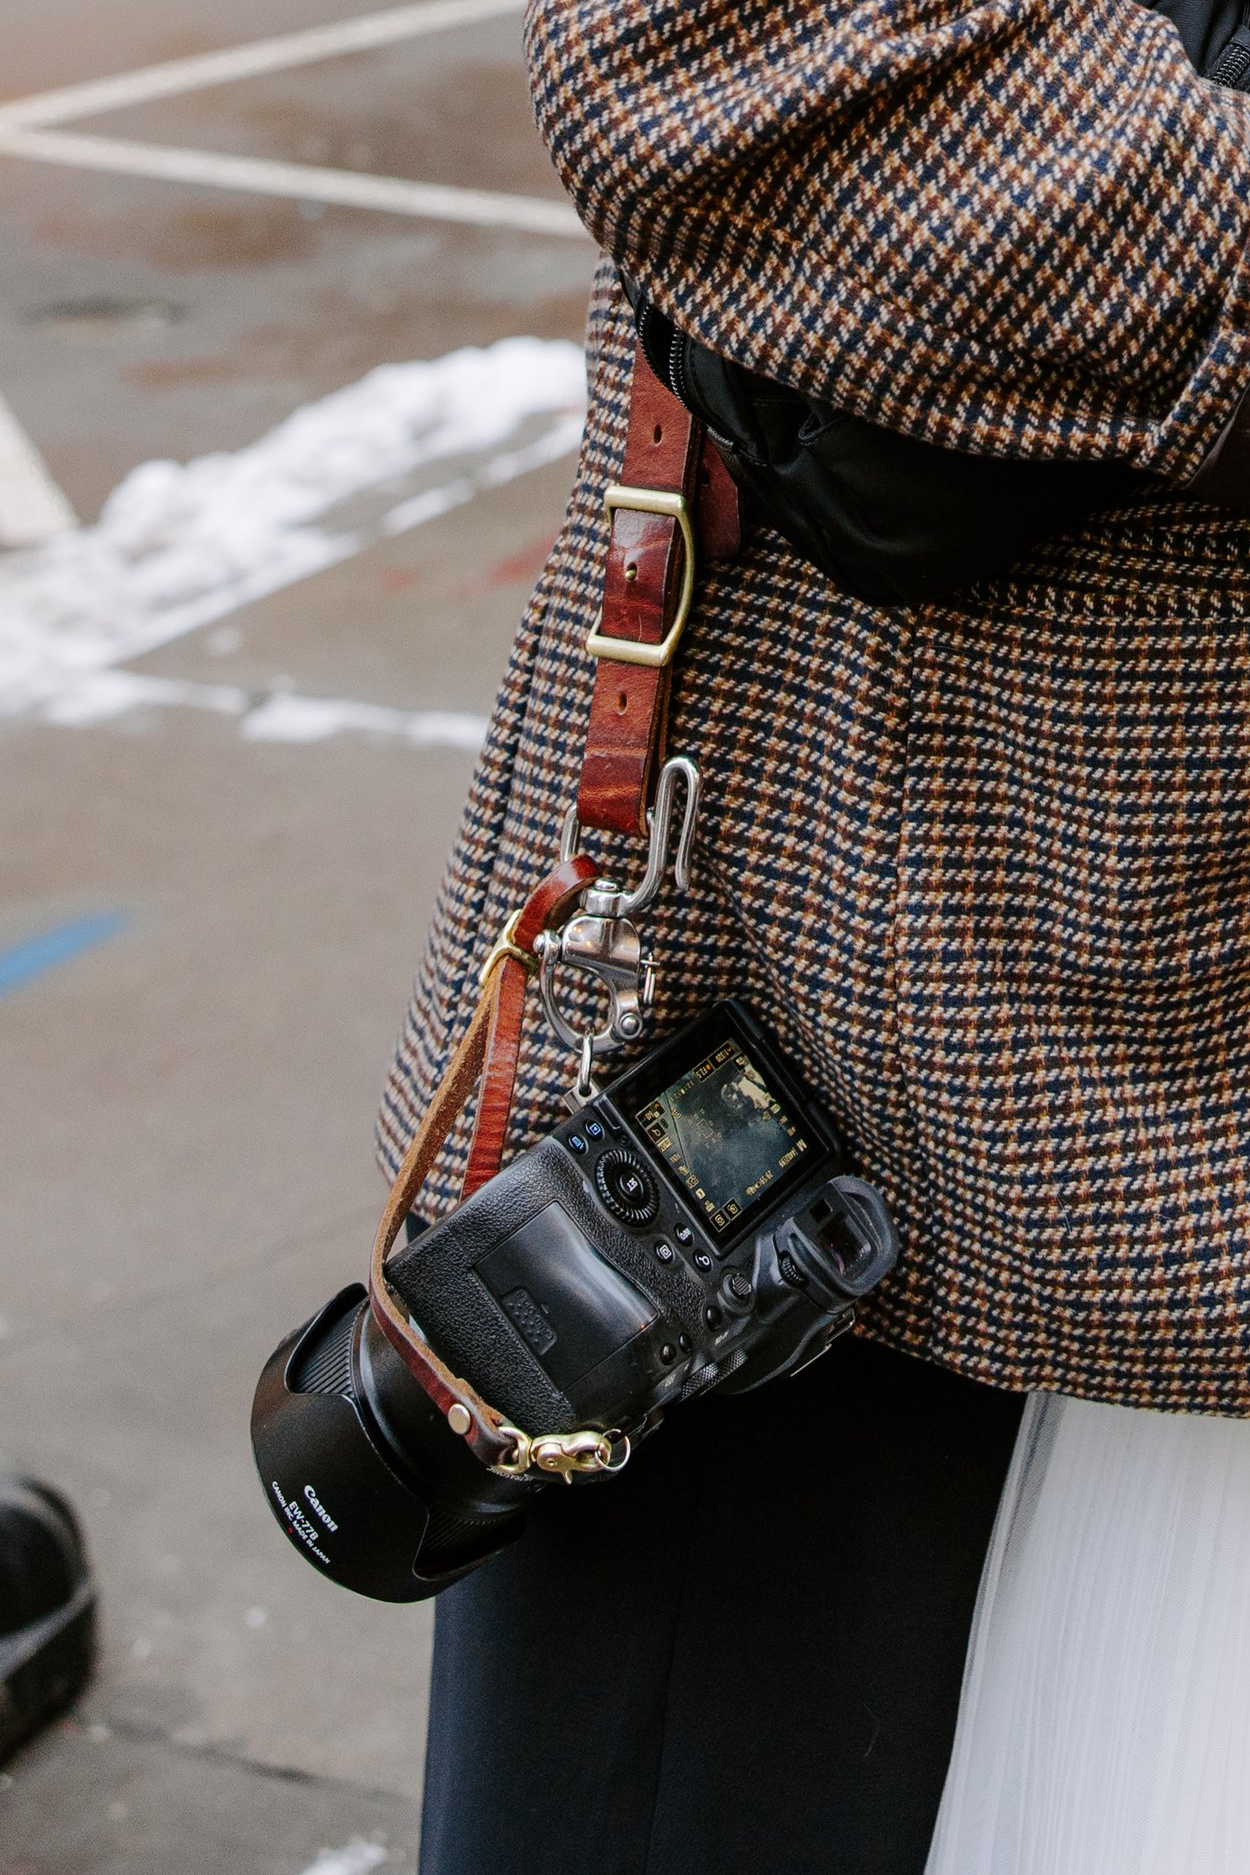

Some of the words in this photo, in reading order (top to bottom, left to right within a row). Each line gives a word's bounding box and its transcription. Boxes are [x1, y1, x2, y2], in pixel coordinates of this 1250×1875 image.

[626, 1178, 638, 1190] SET
[272, 1481, 287, 1507] CANON
[293, 1520, 308, 1540] MADE
[306, 1539, 314, 1547] IN
[312, 1547, 331, 1564] JAPAN
[289, 1501, 319, 1540] EW-77B
[304, 1485, 338, 1532] Canon
